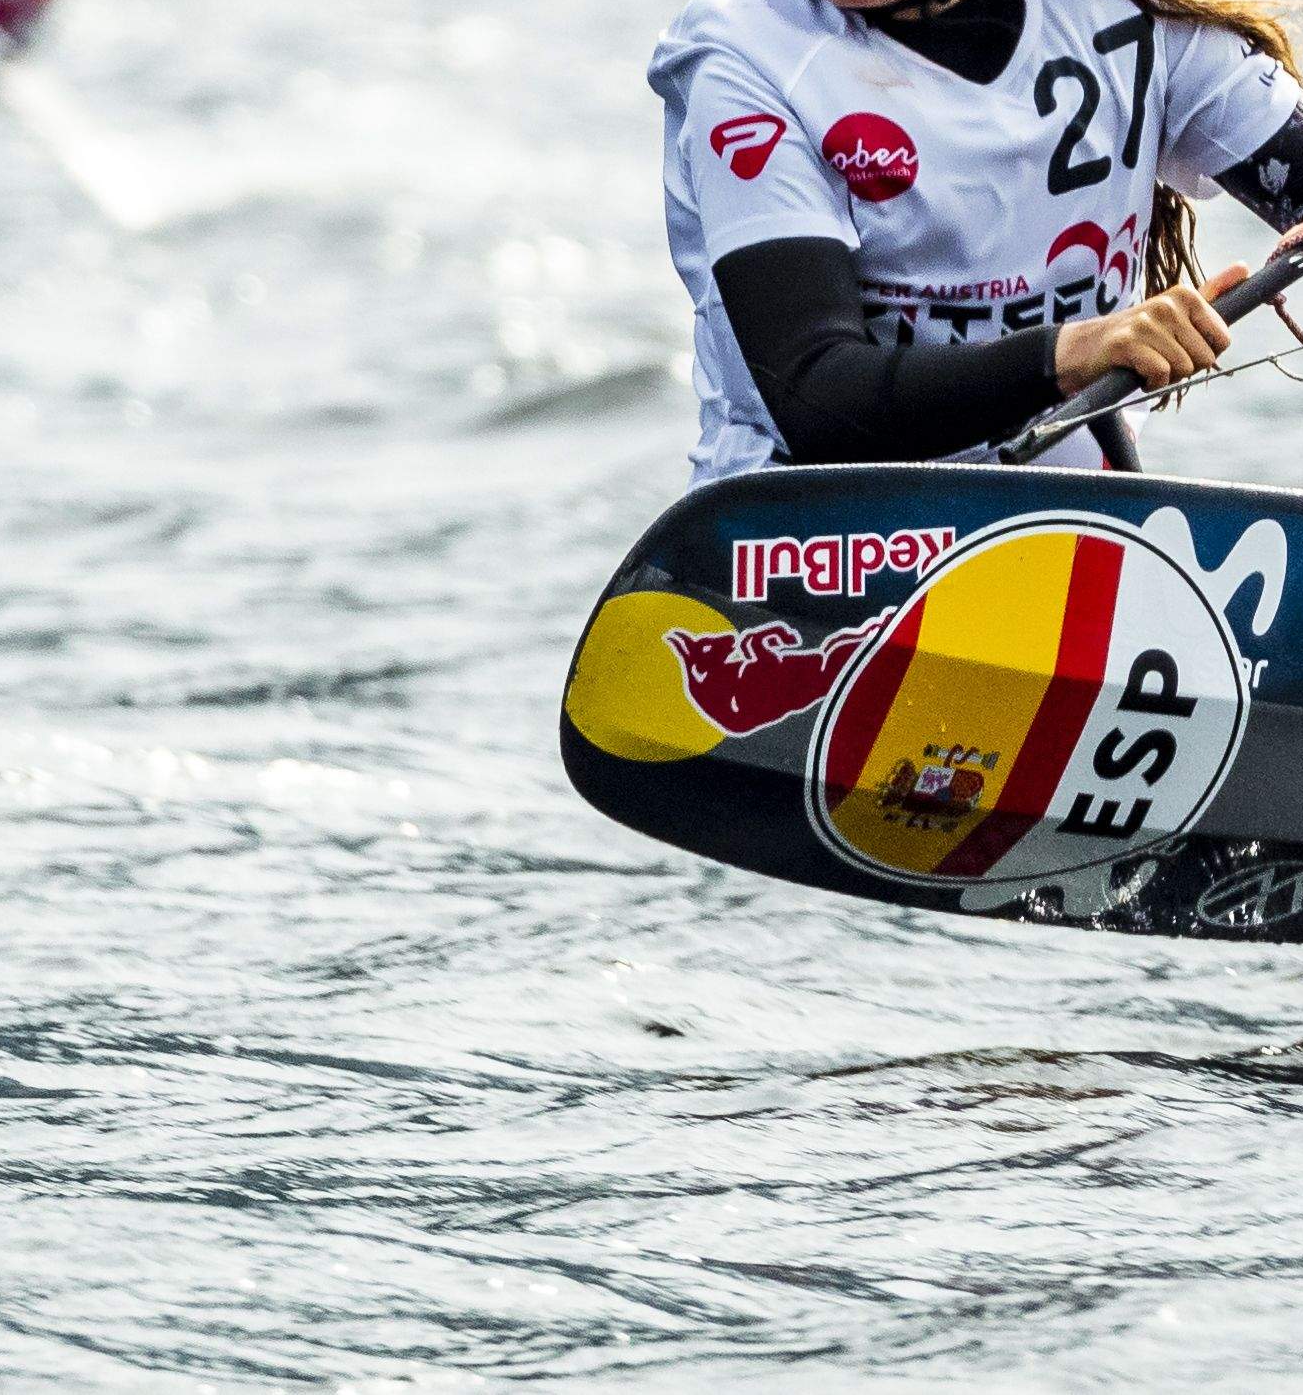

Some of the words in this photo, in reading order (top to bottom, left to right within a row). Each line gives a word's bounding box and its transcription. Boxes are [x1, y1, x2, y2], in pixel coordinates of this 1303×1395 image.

[830, 137, 918, 170] ober
[1033, 13, 1156, 196] 27
[920, 275, 1030, 301] AUSTRIA
[1055, 648, 1198, 840] ESP
